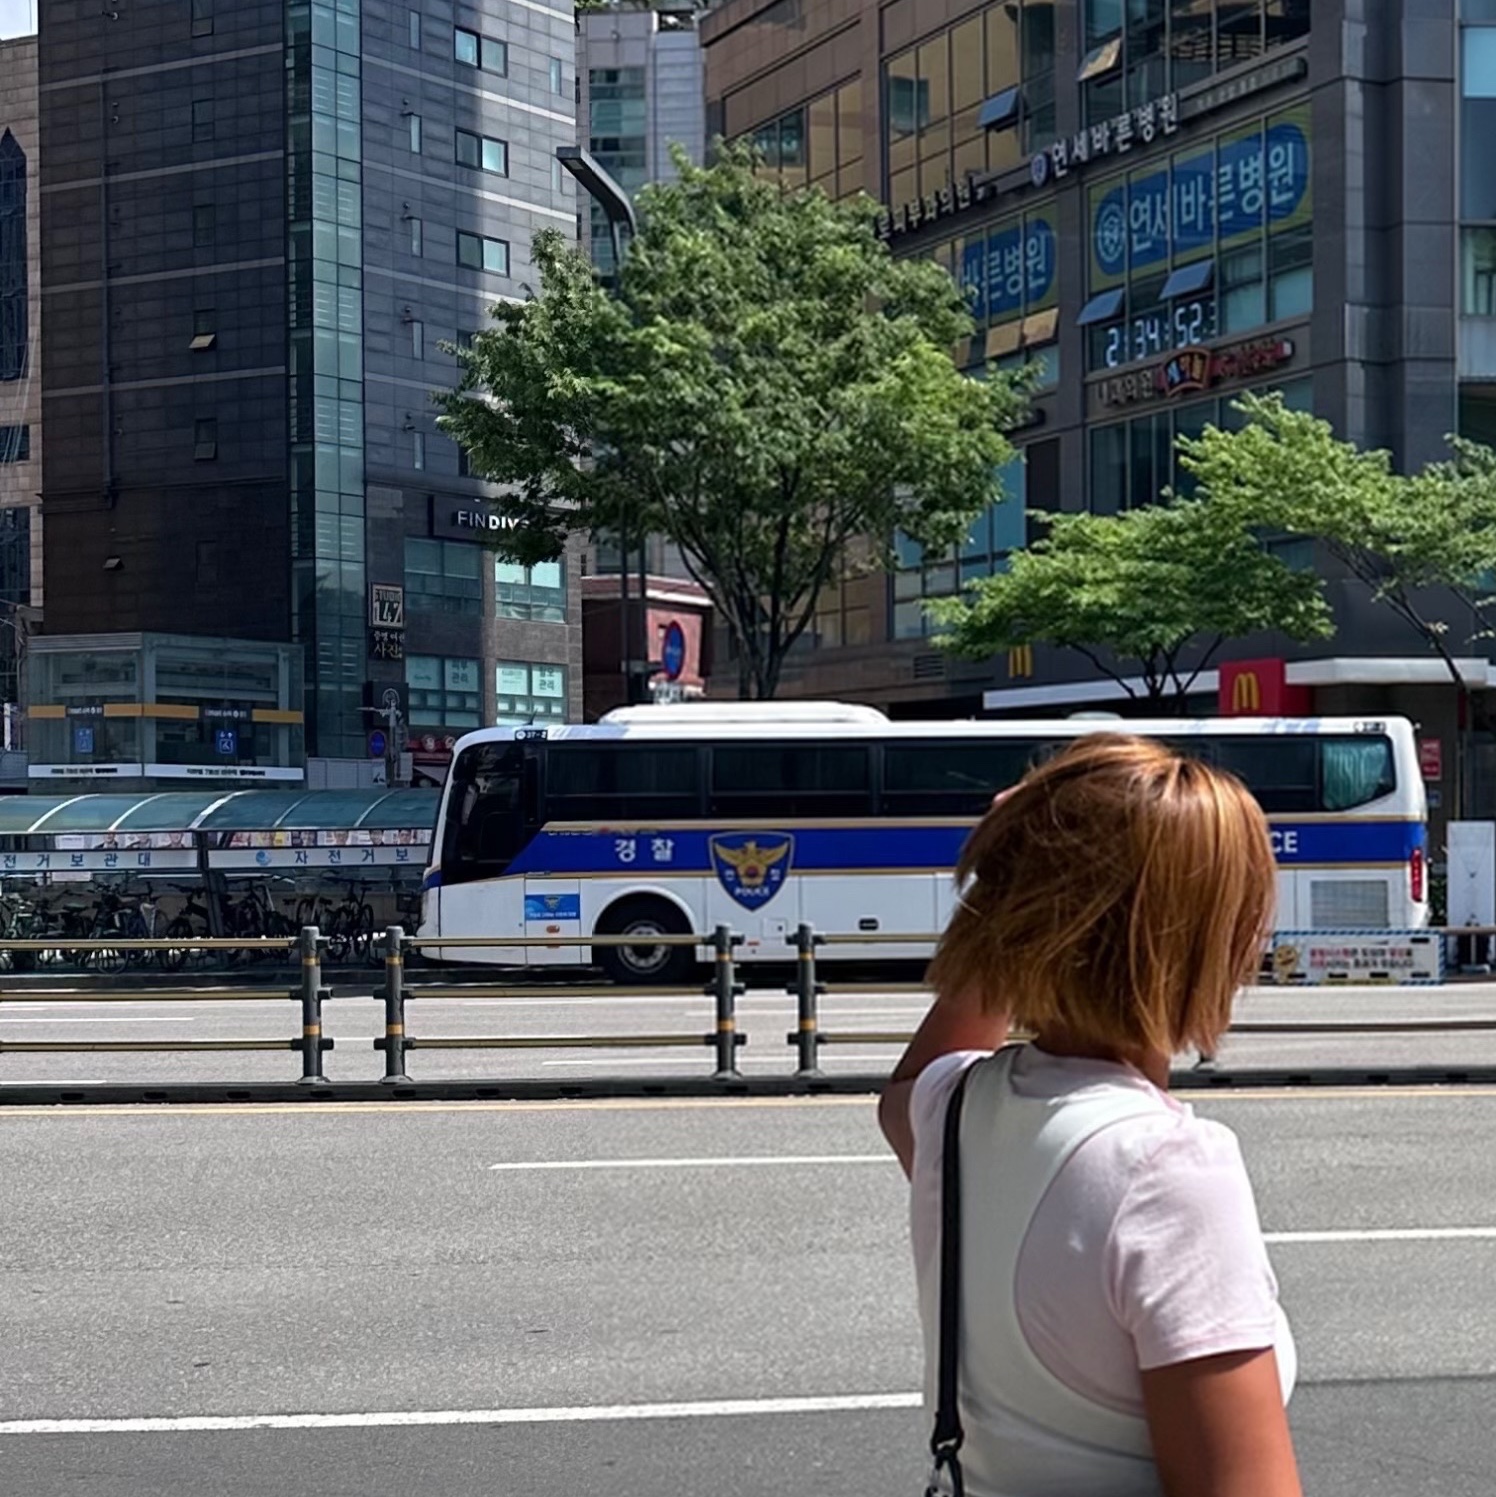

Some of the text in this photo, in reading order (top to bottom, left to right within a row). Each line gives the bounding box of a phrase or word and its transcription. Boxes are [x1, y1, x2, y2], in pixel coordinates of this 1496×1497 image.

[1050, 94, 1178, 178] 연세바른병원
[1130, 141, 1296, 253] 연세바른병원
[615, 837, 675, 863] 경찰
